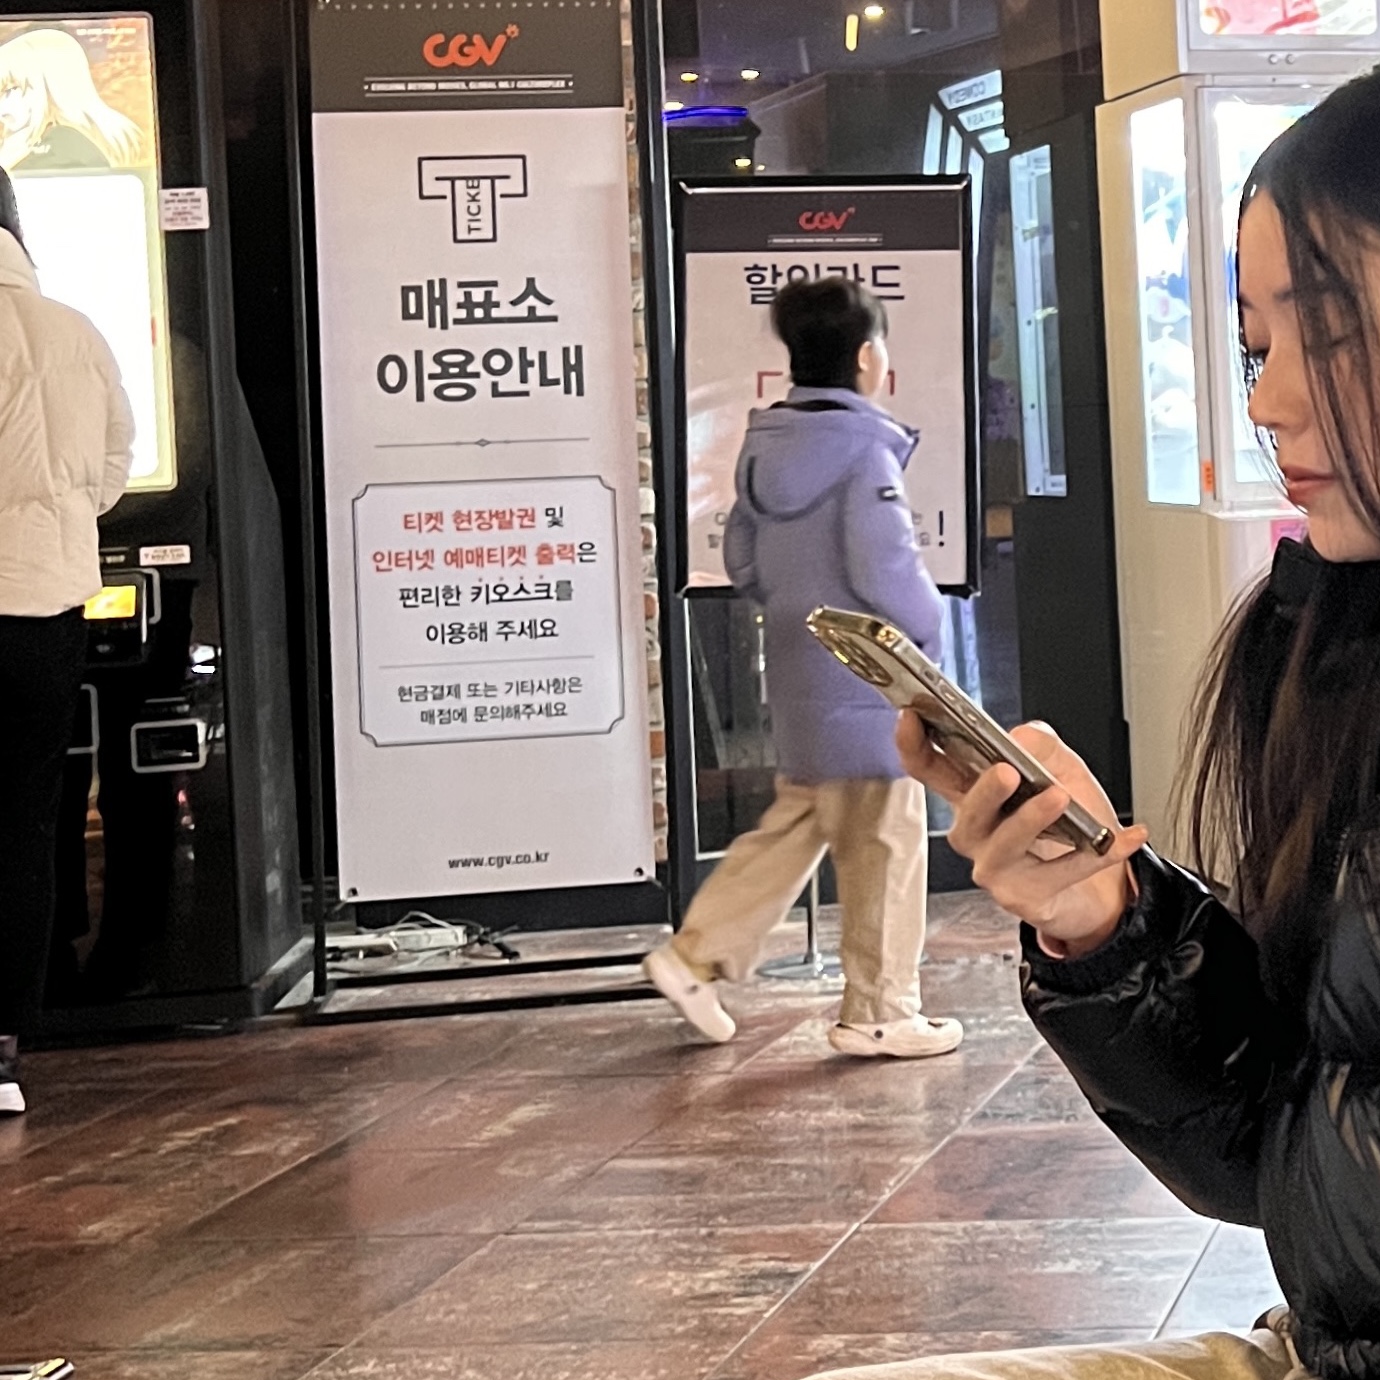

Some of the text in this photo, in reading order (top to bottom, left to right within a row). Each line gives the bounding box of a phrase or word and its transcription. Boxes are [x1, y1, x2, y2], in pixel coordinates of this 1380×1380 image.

[423, 32, 508, 68] CGV
[798, 208, 848, 231] CGV
[400, 277, 560, 331] 매표소
[376, 344, 586, 403] 이용안내
[403, 505, 564, 534] 티켓 현장발권 및
[372, 541, 598, 573] 인터넷 예매티켓 출력은
[399, 584, 462, 609] 편리한
[426, 618, 560, 646] 이용해 주세요
[397, 676, 584, 703] 현금결제 또는 기타사항은
[420, 701, 569, 725] 매점에 문의해주세요
[447, 850, 550, 869] www.cgv.co.kr
